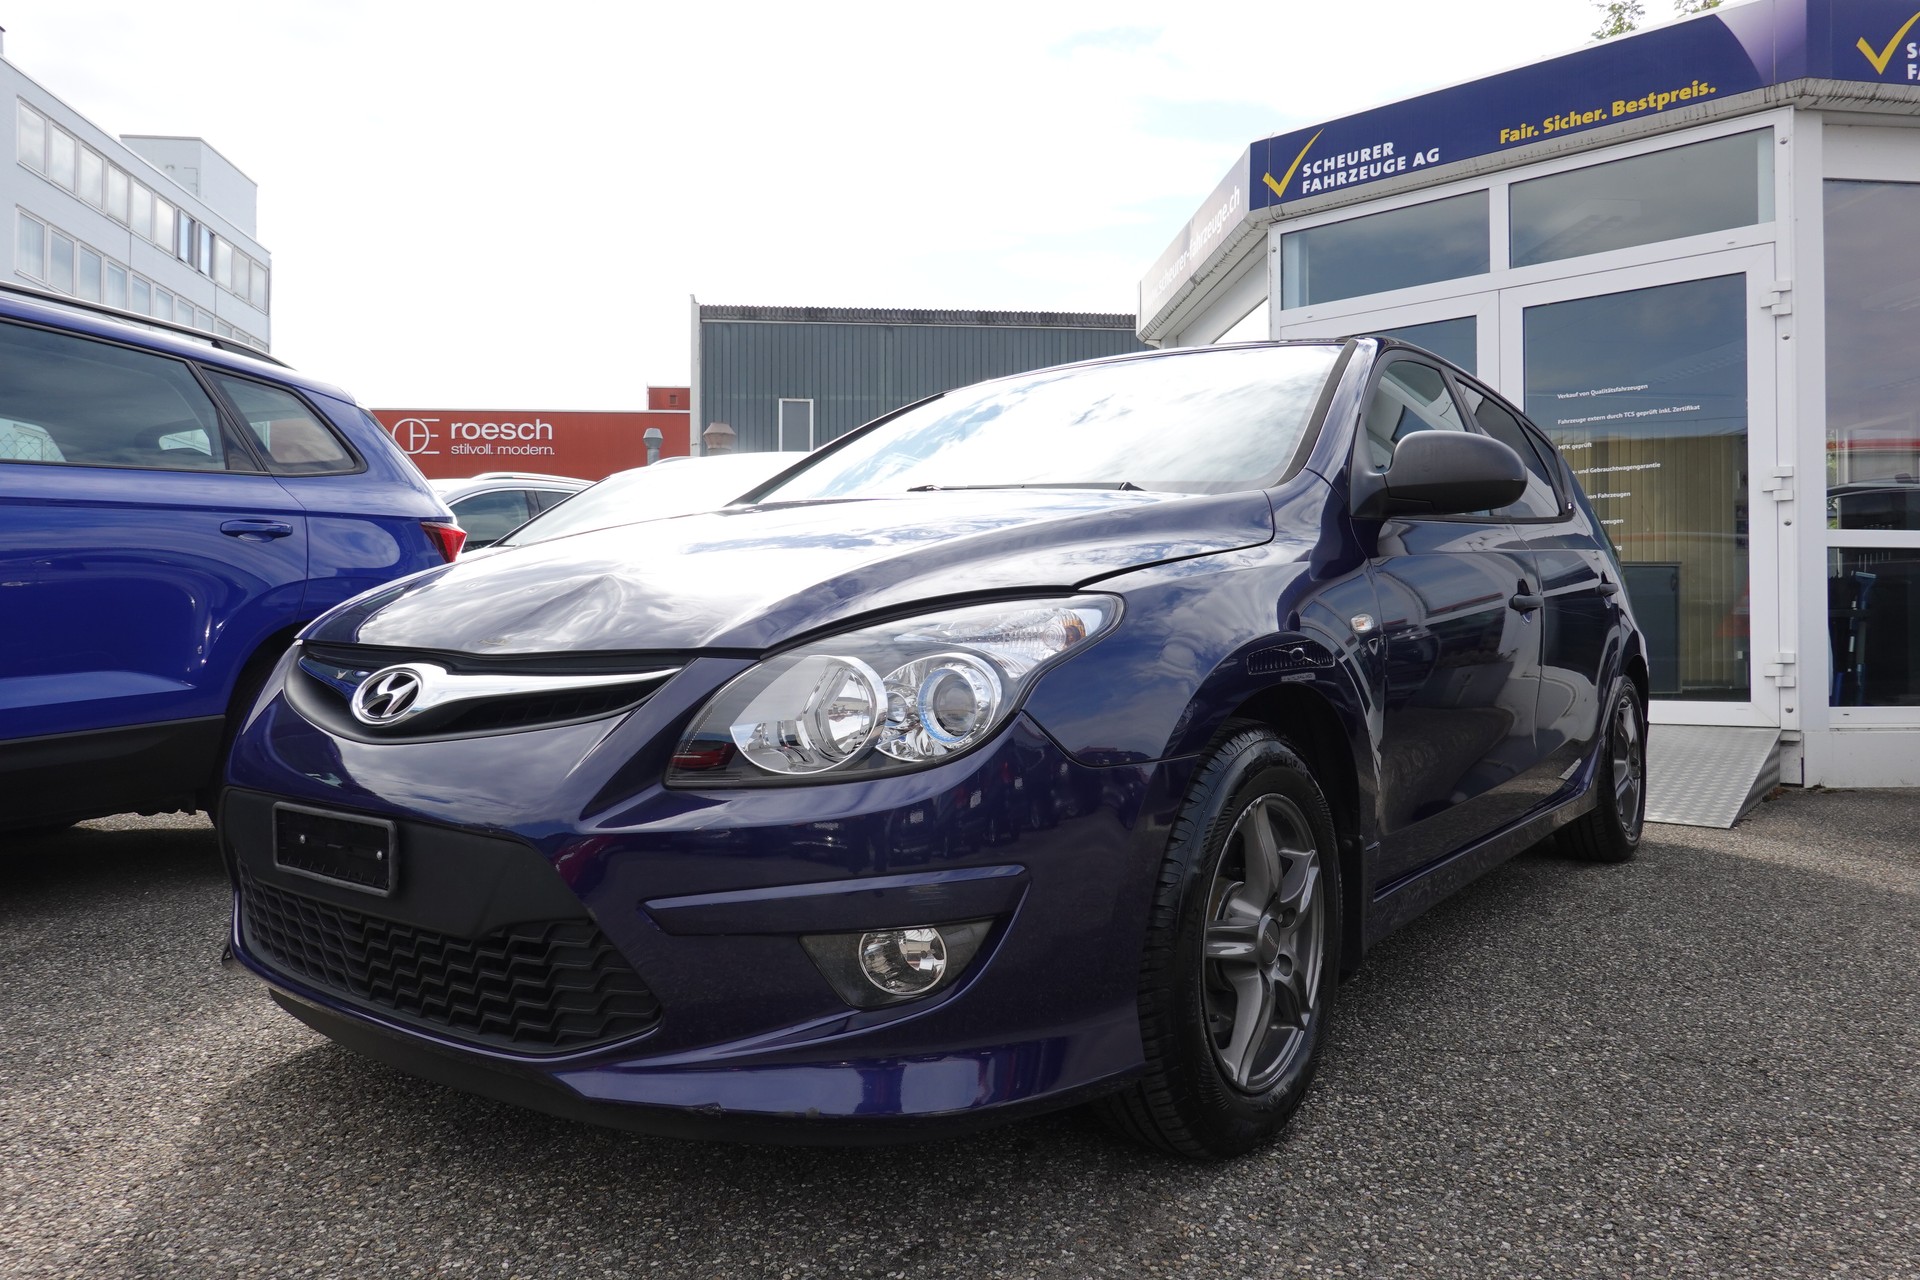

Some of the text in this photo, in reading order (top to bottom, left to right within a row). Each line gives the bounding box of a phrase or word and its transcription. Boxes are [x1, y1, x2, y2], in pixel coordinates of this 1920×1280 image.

[1906, 42, 1920, 59] S
[1500, 80, 1716, 144] Fair. Sicher. Bestpreis.
[1302, 142, 1394, 178] SCHEURER
[1302, 147, 1440, 194] FAHRZEUGE AG
[1590, 384, 1649, 396] Qualitätsfahrzeugen
[1606, 412, 1623, 420] durch
[1635, 408, 1658, 417] geprüft
[1672, 404, 1701, 413] Zertifikat
[451, 418, 553, 440] roesch
[451, 443, 555, 455] stilvoll. modern.
[1571, 442, 1592, 450] geprüft
[1589, 462, 1661, 473] Gebrauchtwagengarantie
